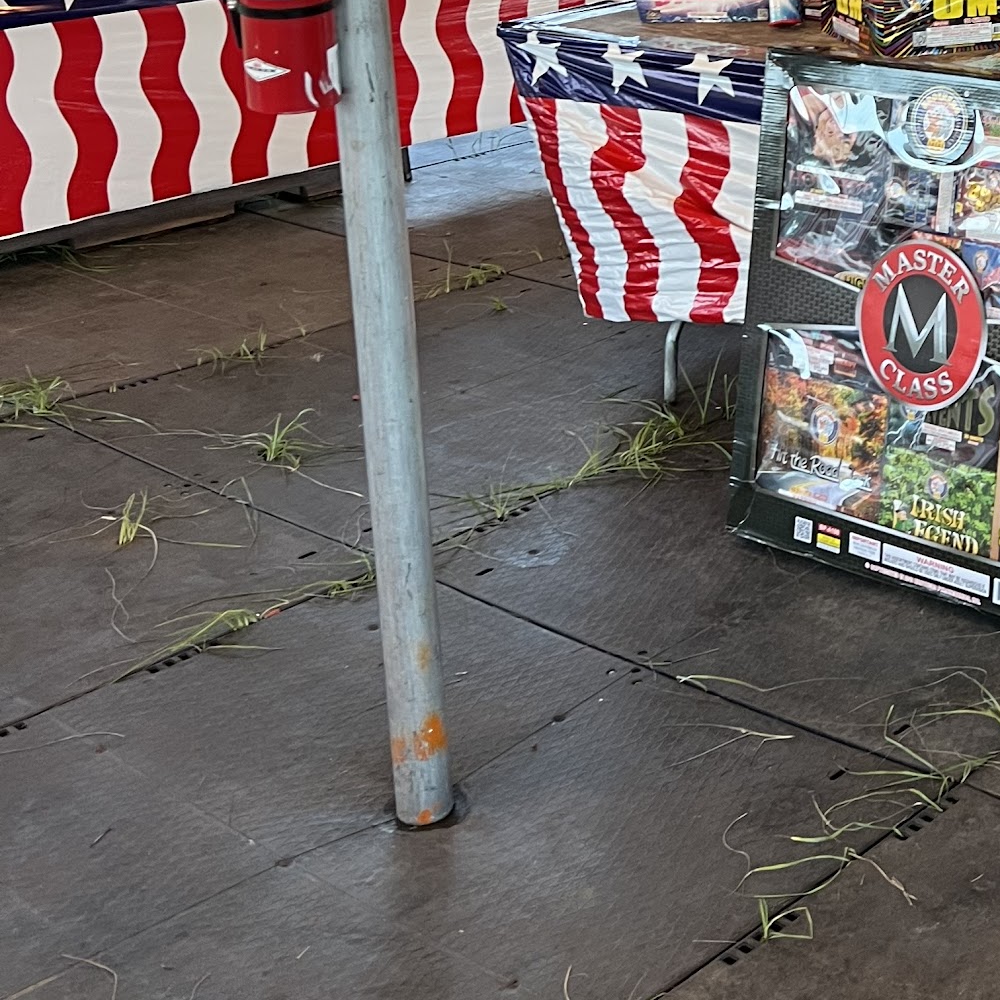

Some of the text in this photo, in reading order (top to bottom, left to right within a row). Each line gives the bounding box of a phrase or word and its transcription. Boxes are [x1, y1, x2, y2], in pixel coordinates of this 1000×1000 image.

[872, 249, 970, 304] MASTER
[883, 282, 952, 366] M
[879, 358, 954, 400] CLASS
[910, 495, 966, 530] IRISH
[908, 518, 979, 555] EGEND
[917, 555, 955, 574] WARNING
